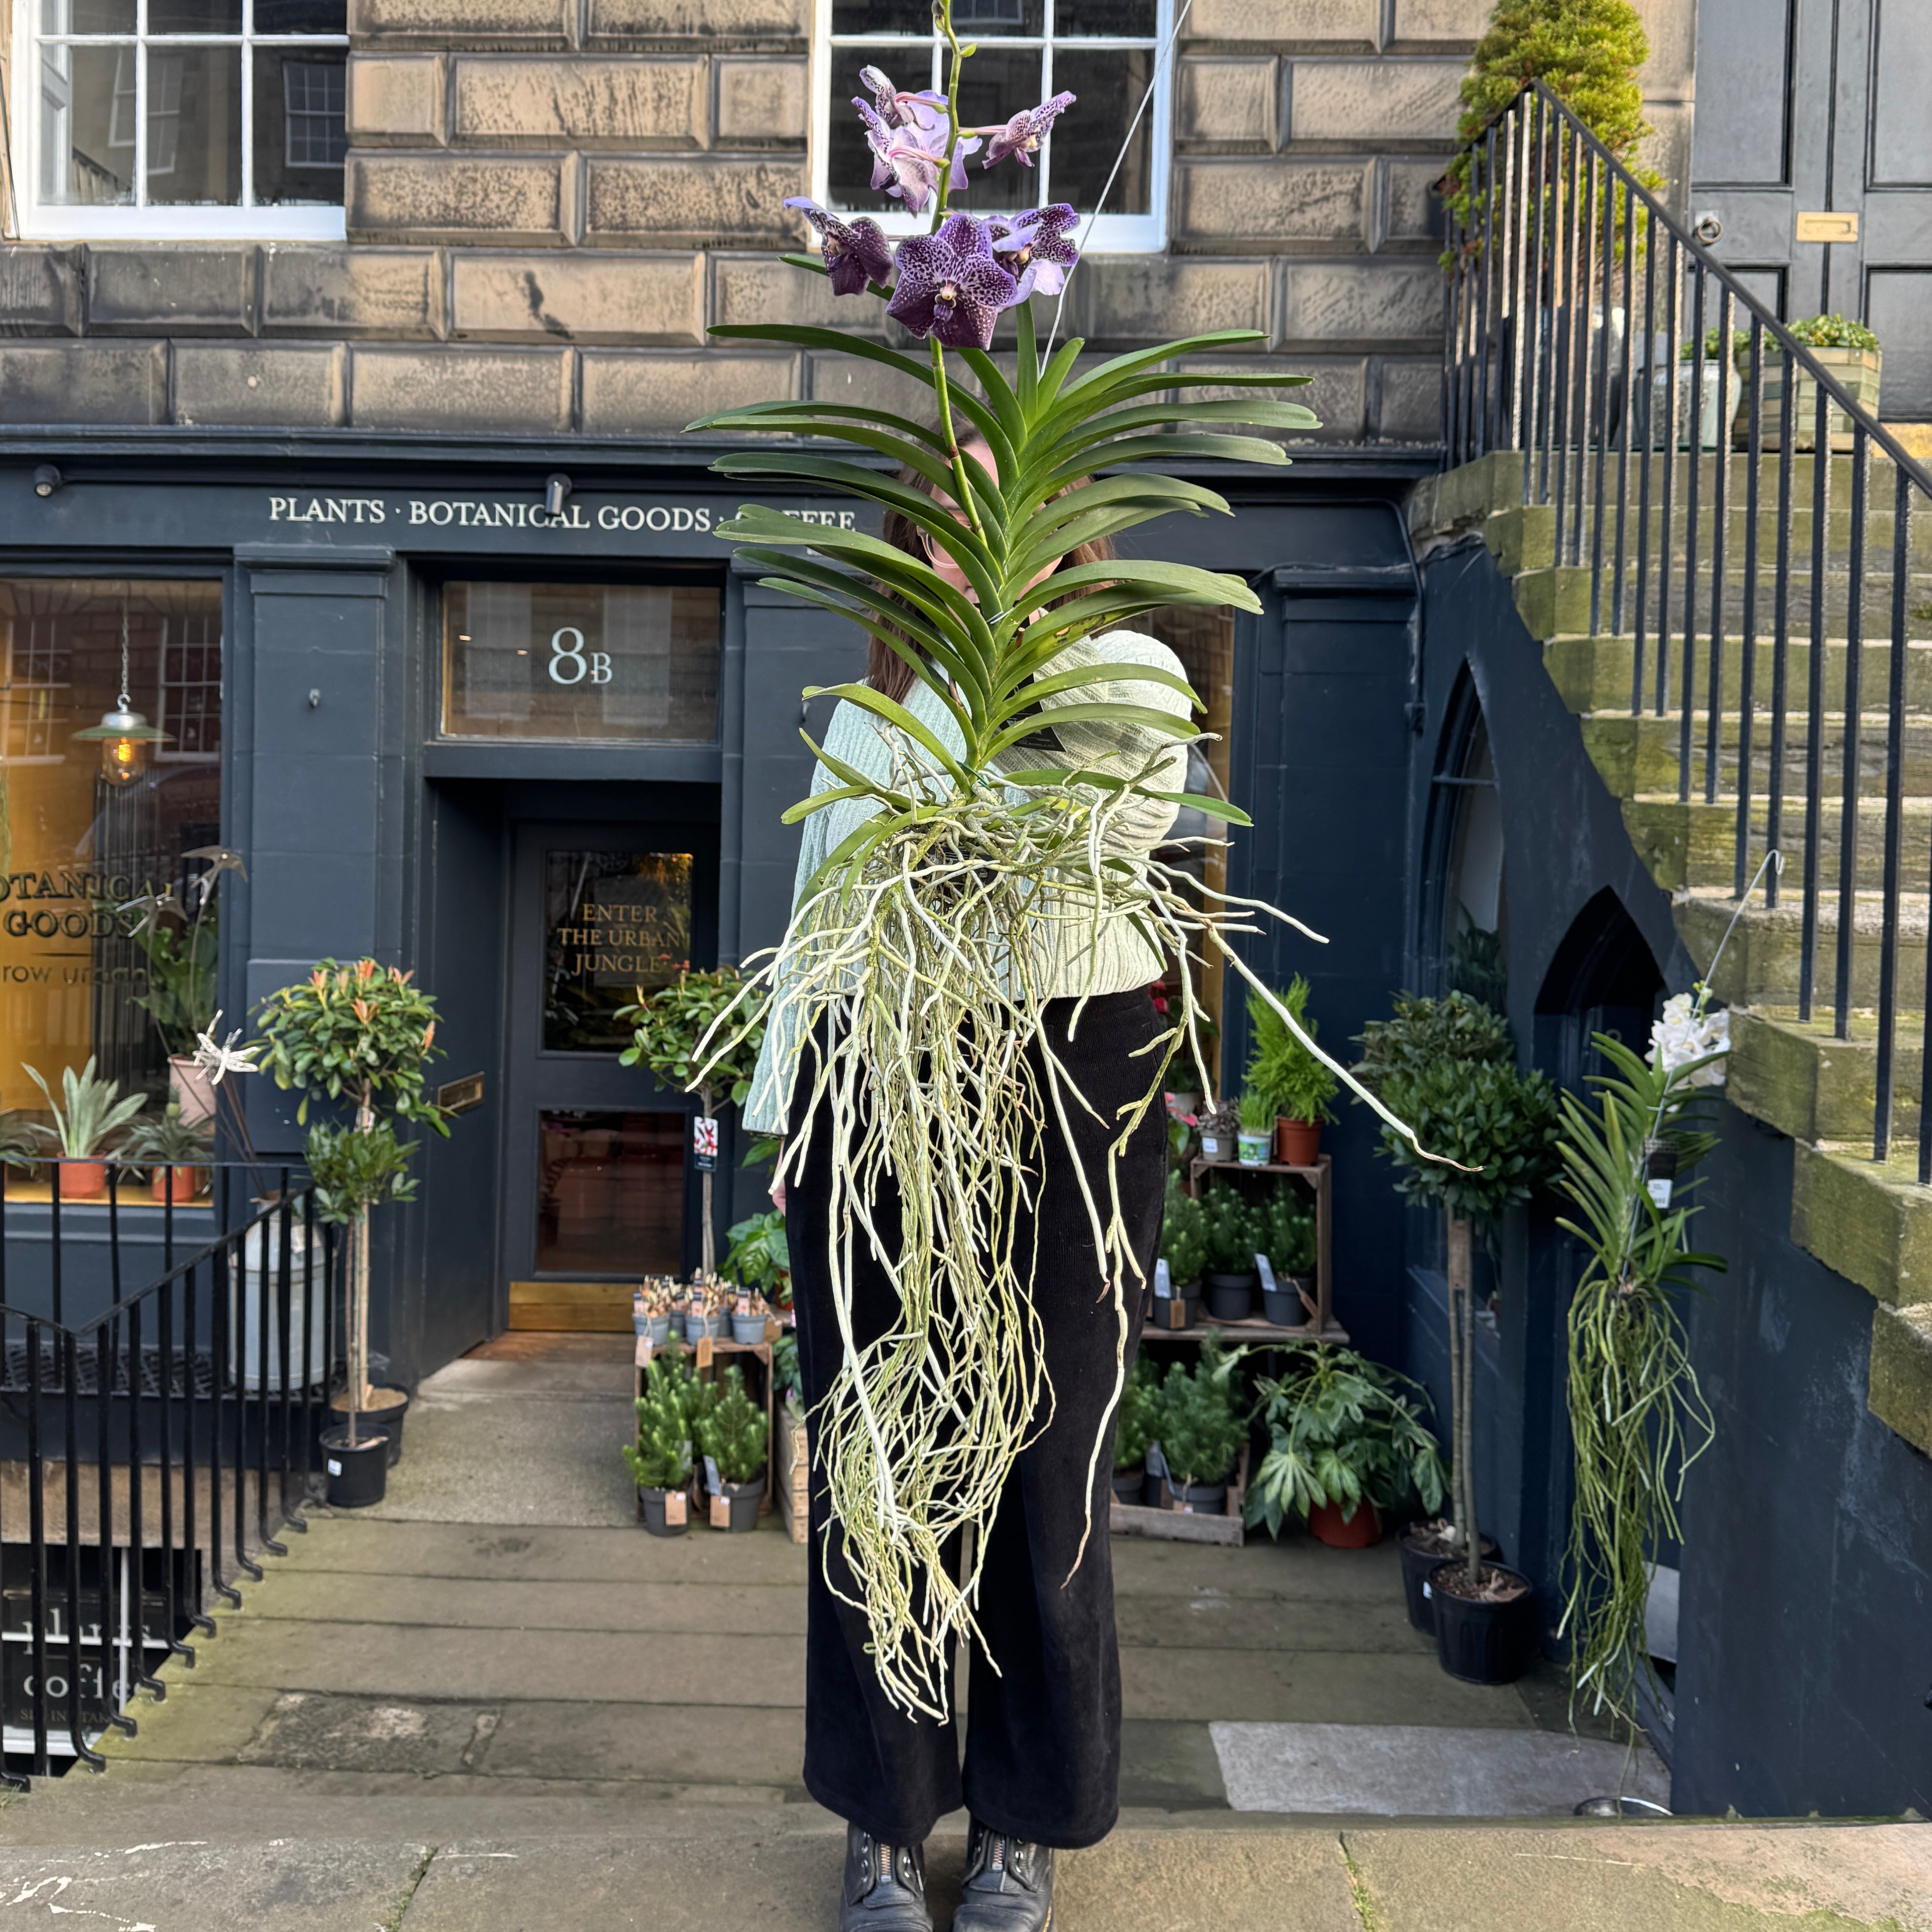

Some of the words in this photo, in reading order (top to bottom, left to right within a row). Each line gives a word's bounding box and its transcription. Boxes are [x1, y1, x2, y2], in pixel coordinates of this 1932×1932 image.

[268, 497, 385, 524] PLANTS
[408, 501, 591, 529] BOTANICAL
[597, 505, 711, 532] GOODS
[548, 626, 613, 685] 8B
[3, 909, 135, 938] GOODS
[582, 903, 658, 924] ENTER
[556, 928, 603, 947] THE
[609, 930, 680, 948] URBAN
[571, 953, 661, 977] JUNGLE
